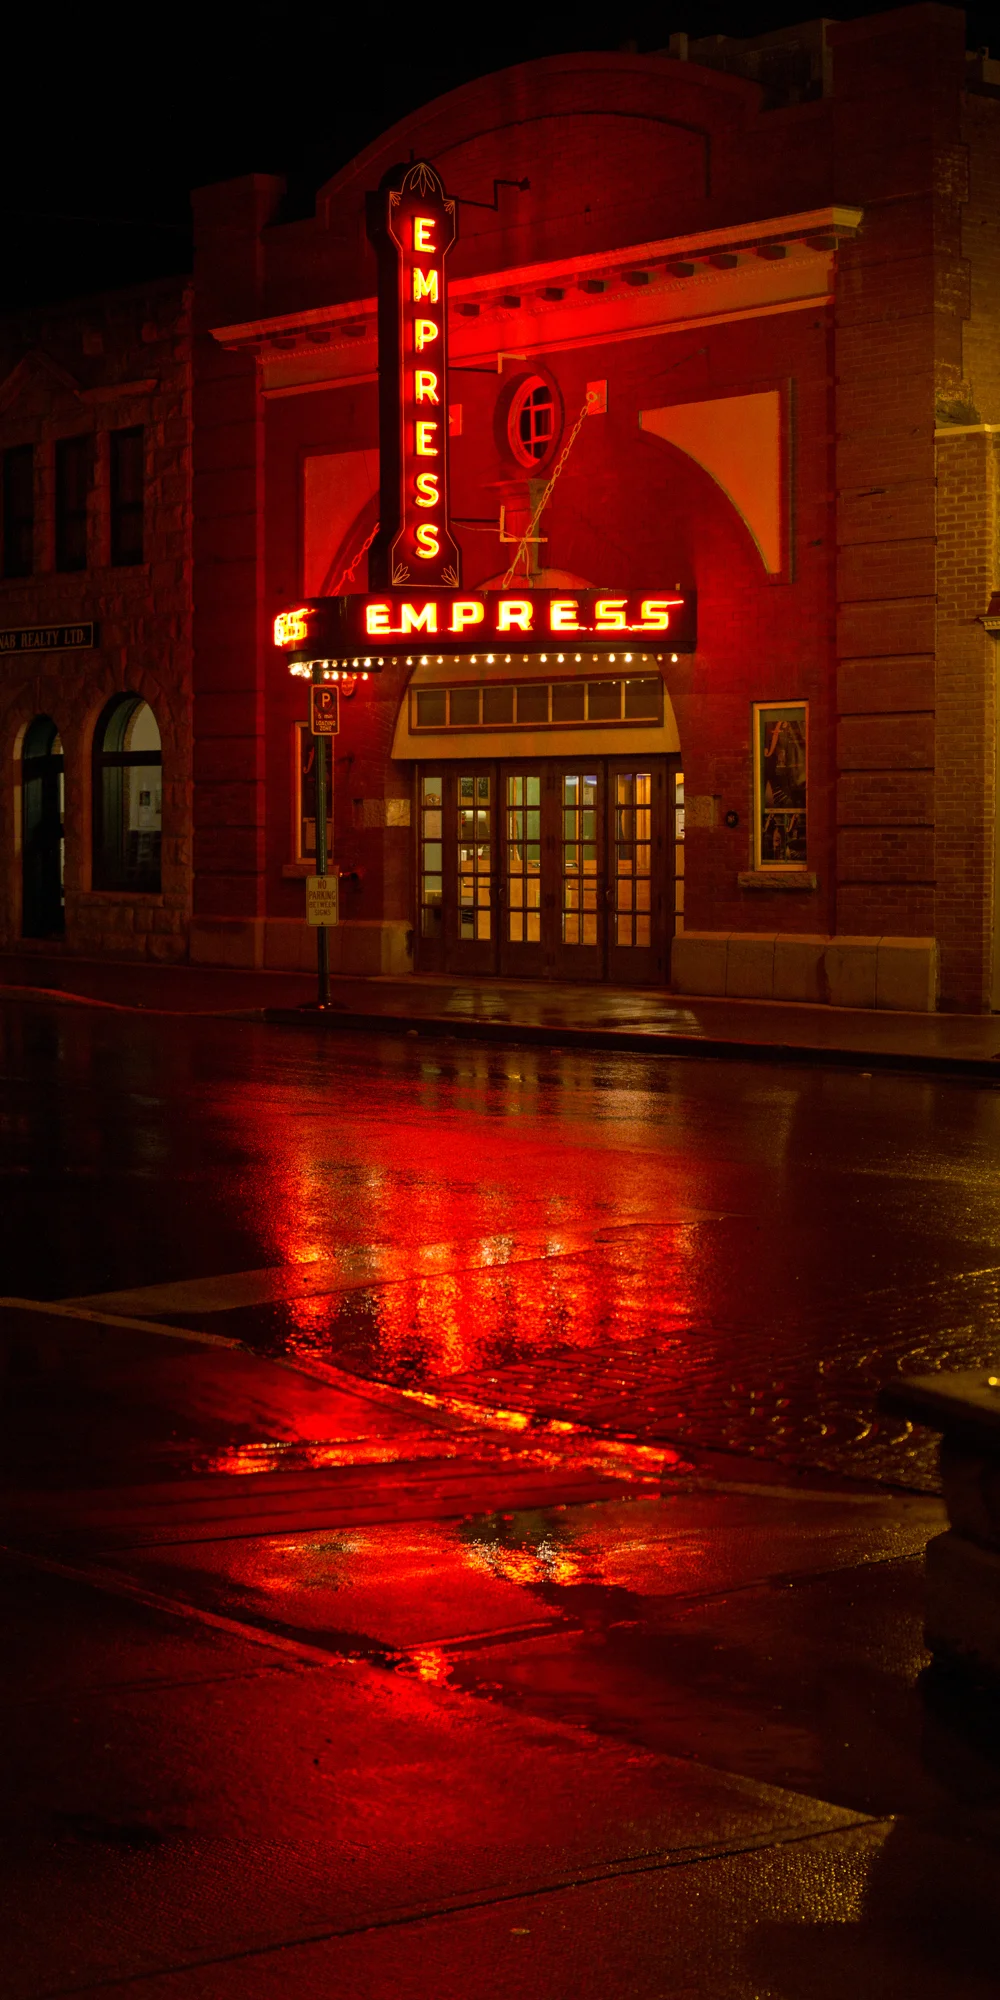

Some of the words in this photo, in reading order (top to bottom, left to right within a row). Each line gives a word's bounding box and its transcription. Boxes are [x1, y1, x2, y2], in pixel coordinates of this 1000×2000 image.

[412, 216, 440, 559] EMPRESS
[365, 600, 685, 635] EMPRESS
[21, 630, 60, 648] REALTY
[64, 628, 87, 645] LTD.
[322, 692, 331, 708] P
[317, 880, 327, 889] NO
[308, 891, 336, 900] PARKING
